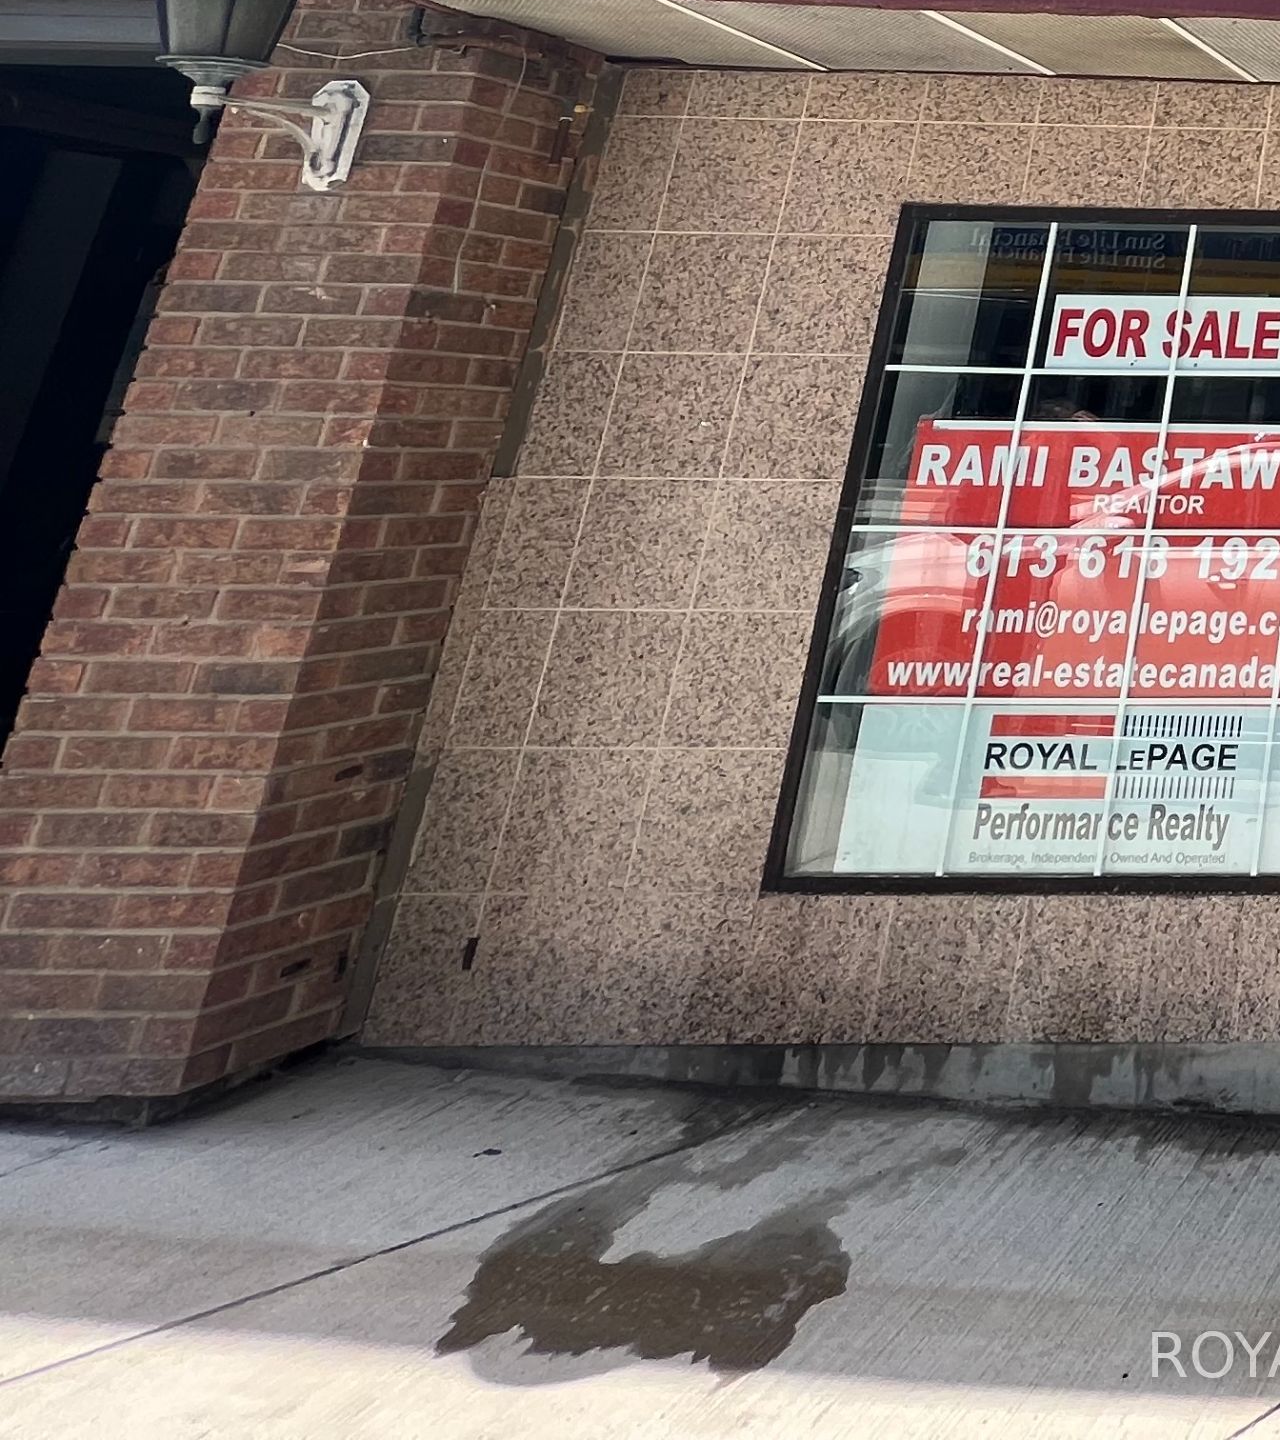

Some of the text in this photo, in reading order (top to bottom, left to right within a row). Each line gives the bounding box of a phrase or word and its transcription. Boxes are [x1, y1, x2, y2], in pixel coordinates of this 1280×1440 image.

[1053, 308, 1150, 358] FOR
[915, 444, 1050, 488] RAMI
[1092, 493, 1206, 516] REALTOR
[966, 533, 1059, 579] 613
[1077, 534, 1170, 580] 618
[983, 742, 1098, 771] ROYAL
[1146, 803, 1231, 851] Realty
[1030, 851, 1108, 867] Independen
[1110, 851, 1149, 864] Owned
[1151, 851, 1172, 864] And
[1175, 851, 1226, 866] Operated
